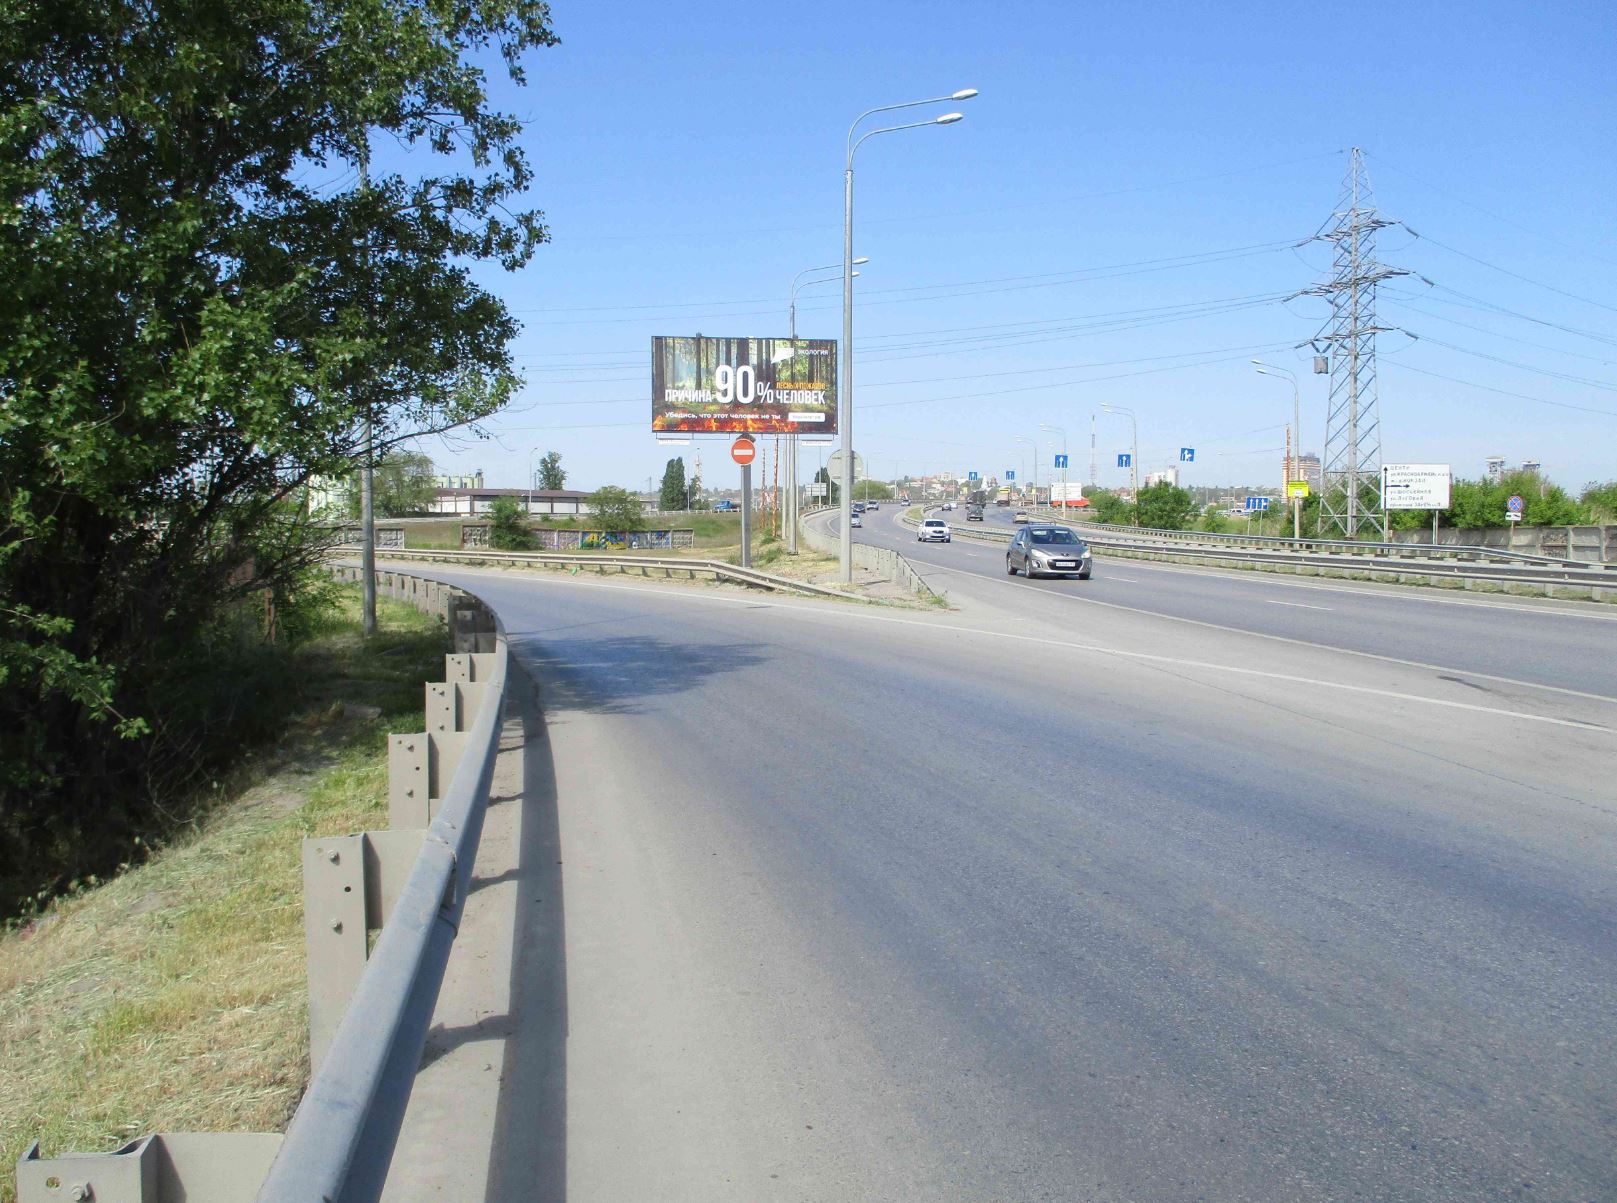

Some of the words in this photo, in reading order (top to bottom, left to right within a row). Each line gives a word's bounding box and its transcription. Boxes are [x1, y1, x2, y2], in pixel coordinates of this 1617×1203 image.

[665, 389, 712, 403] ПРИЧИНА
[776, 390, 826, 404] ЧЕЛОВЕК
[665, 411, 698, 419] Убедись,
